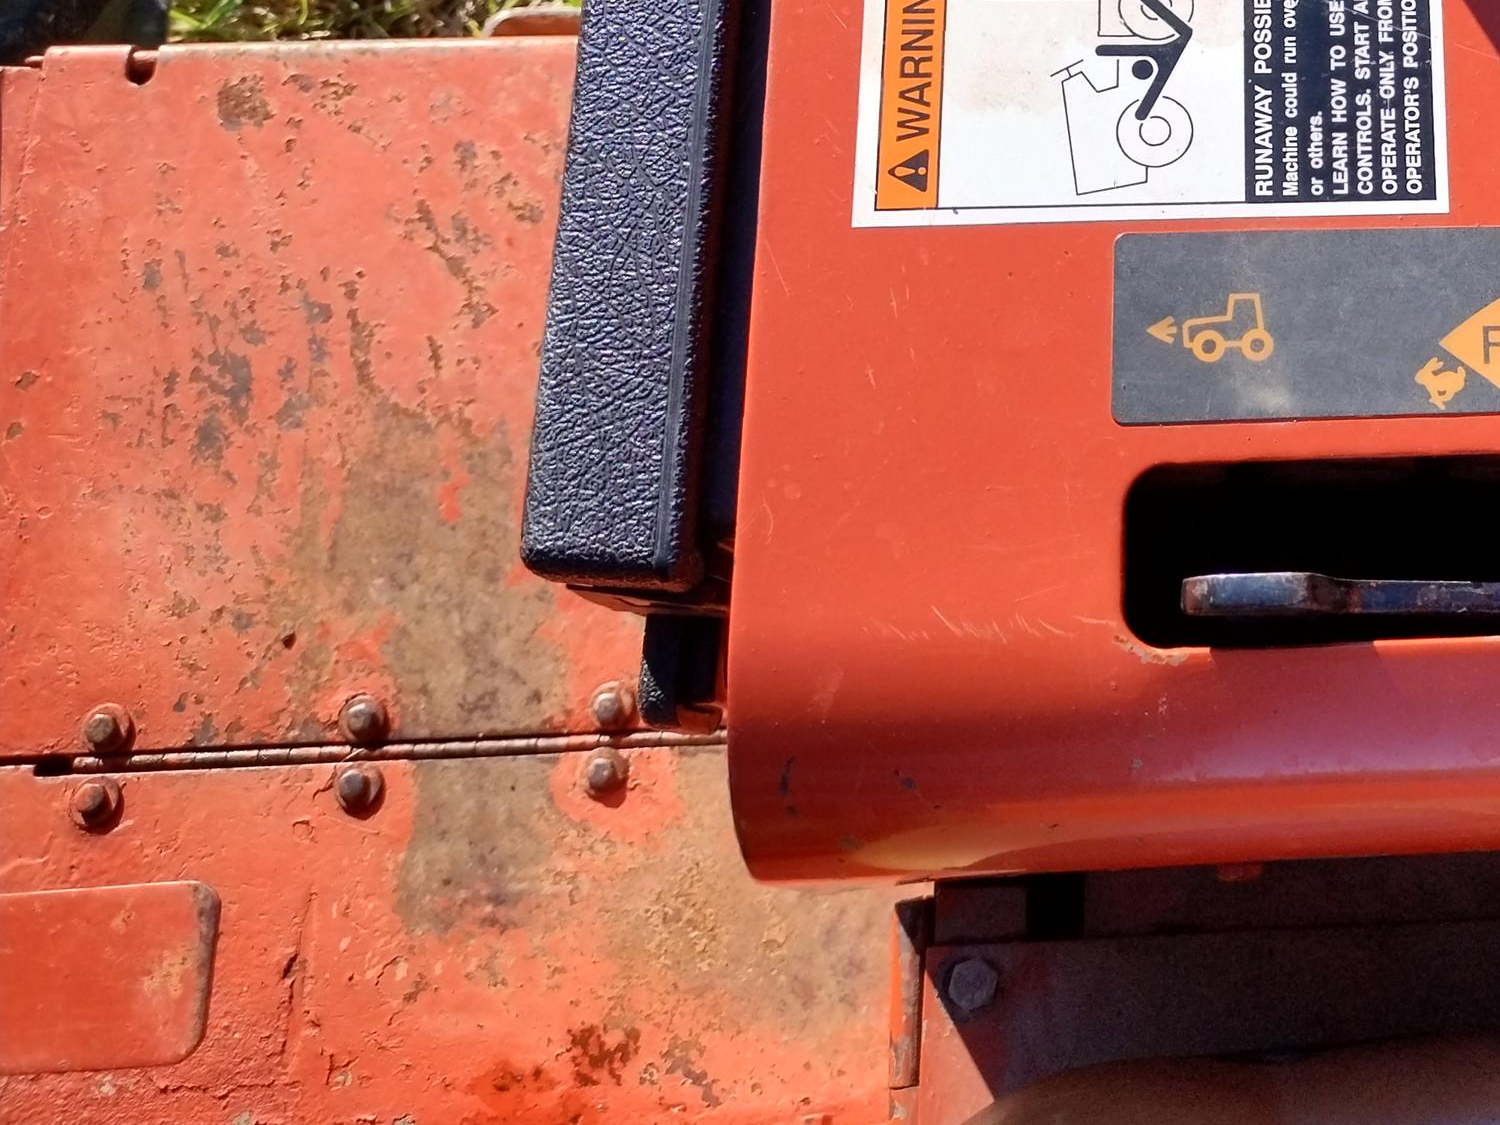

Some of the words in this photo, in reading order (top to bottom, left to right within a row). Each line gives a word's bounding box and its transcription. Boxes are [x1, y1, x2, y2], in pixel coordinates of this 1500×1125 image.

[1328, 0, 1346, 36] USE
[1283, 36, 1297, 64] run
[1329, 47, 1347, 71] TO
[1354, 21, 1371, 80] START
[1378, 50, 1396, 99] ONLY
[1281, 72, 1298, 118] could
[1330, 78, 1348, 123] HOW
[1254, 85, 1274, 196] RUNAWAY
[1282, 126, 1299, 196] Machine
[1307, 111, 1324, 169] others.
[1332, 131, 1349, 195] LEARN
[1355, 88, 1374, 195] CONTROLS.
[1380, 107, 1398, 195] OPERATE
[1403, 76, 1423, 195] OPERATOR'S
[1310, 177, 1324, 195] or
